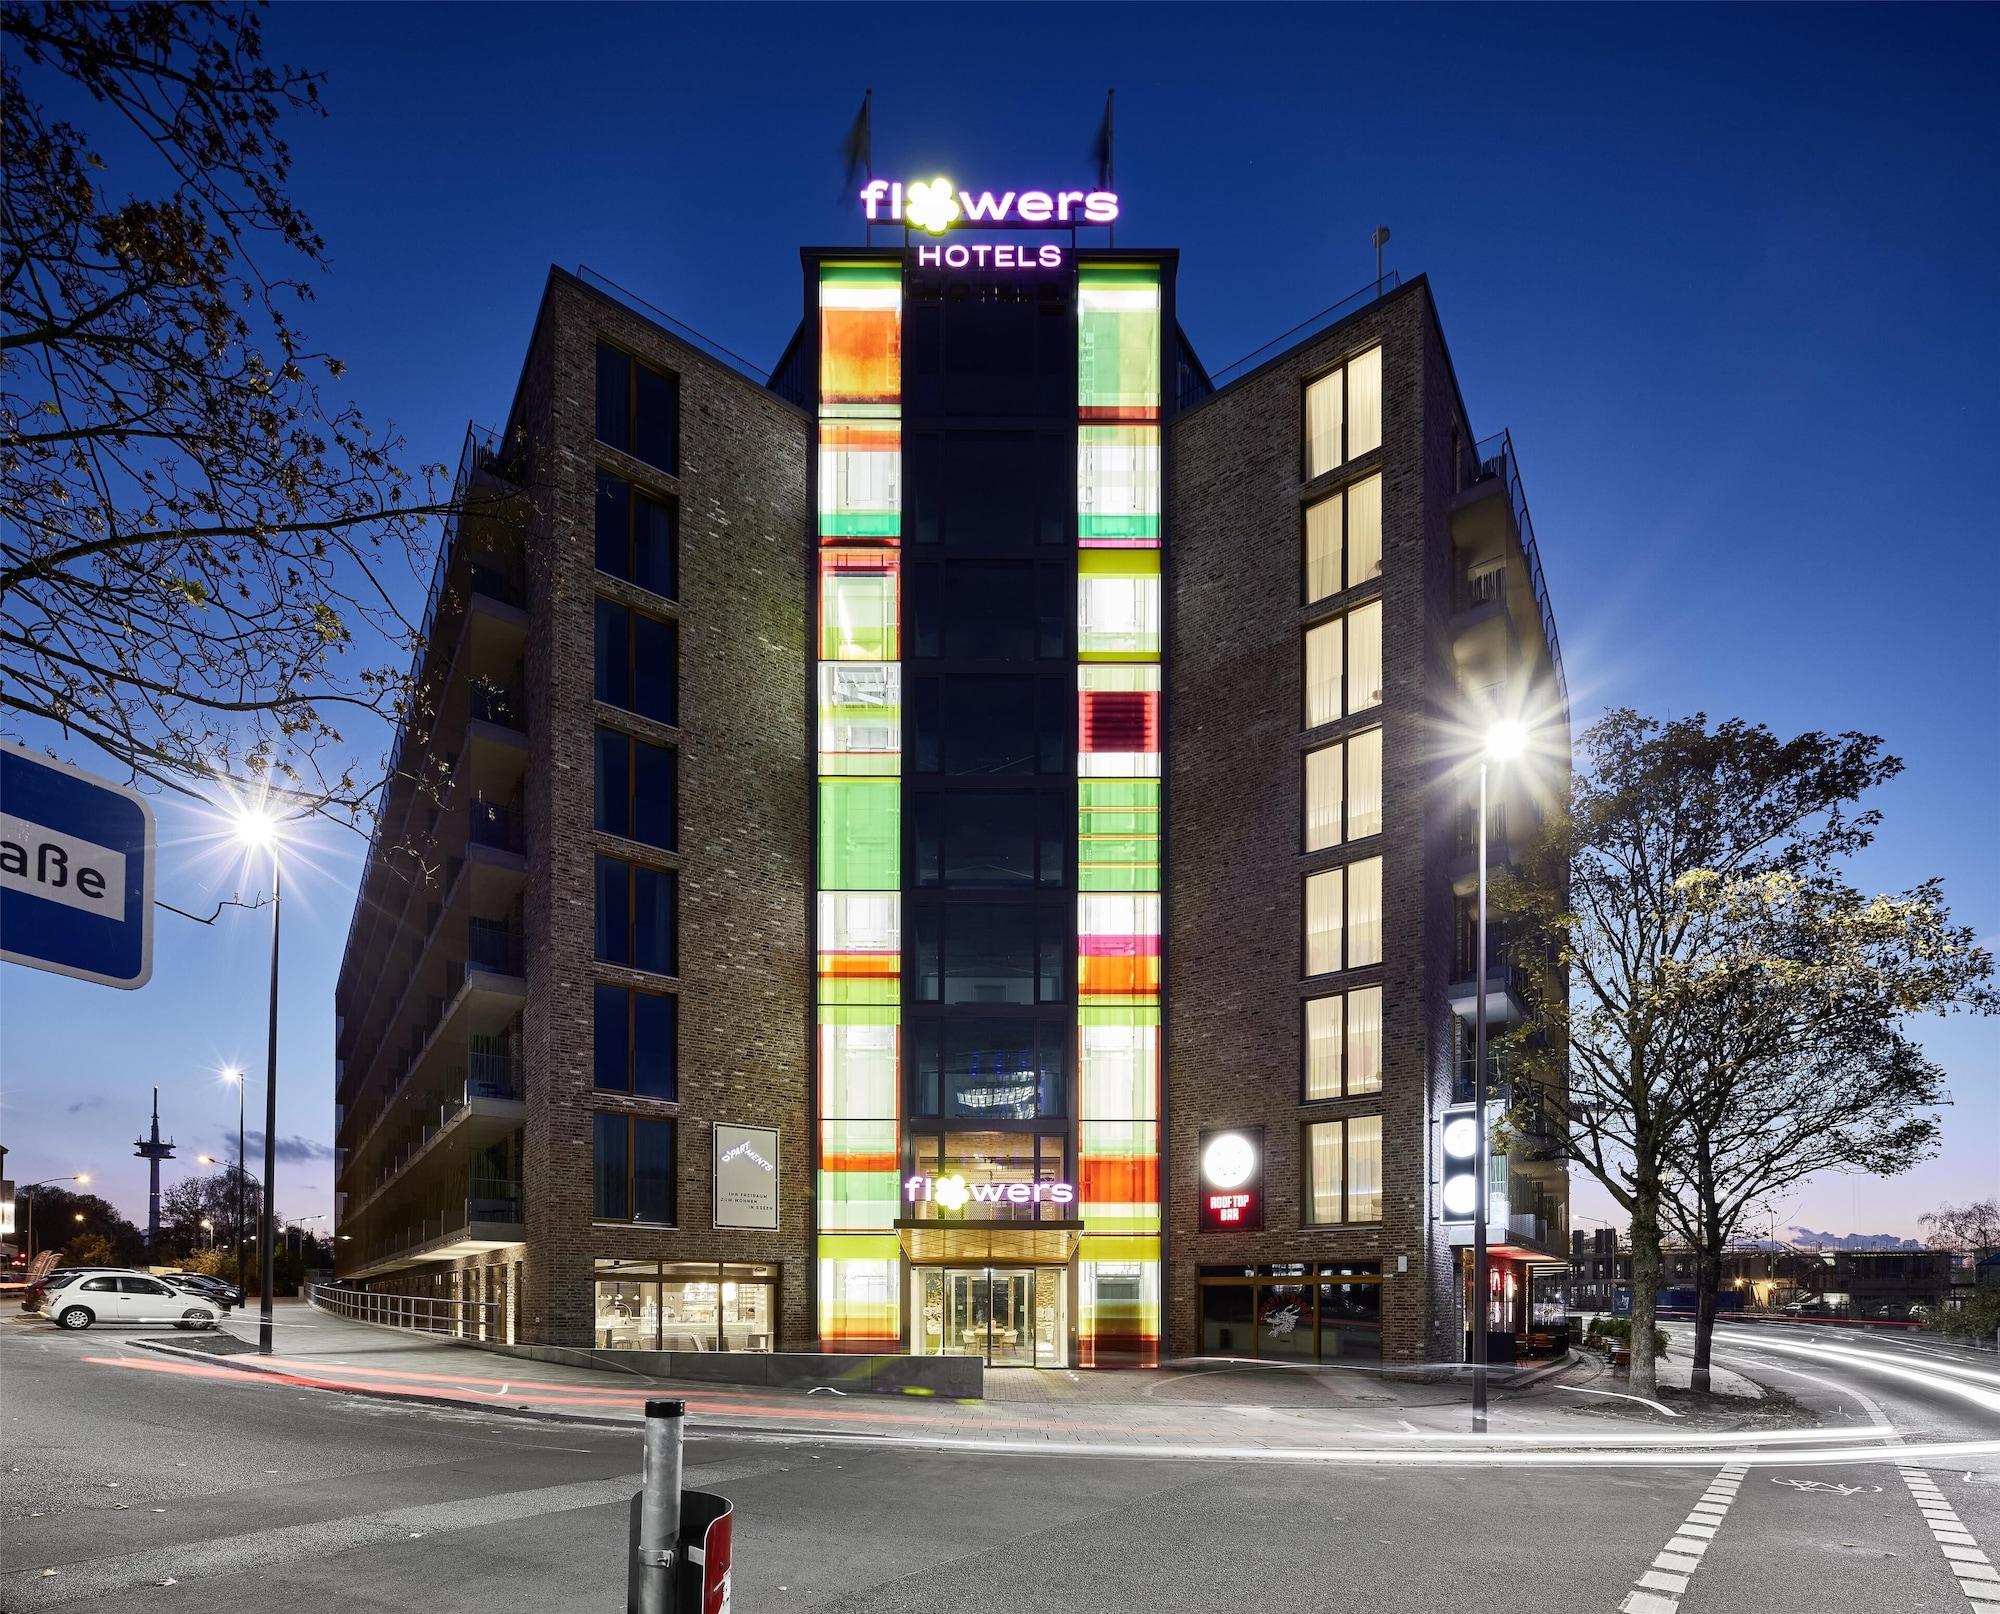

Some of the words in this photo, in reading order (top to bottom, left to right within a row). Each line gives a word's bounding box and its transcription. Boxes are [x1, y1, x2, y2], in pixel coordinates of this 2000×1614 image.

[918, 245, 1062, 268] HOTELS
[1210, 1195, 1249, 1209] ROOFTOP
[1220, 1208, 1239, 1221] BAR
